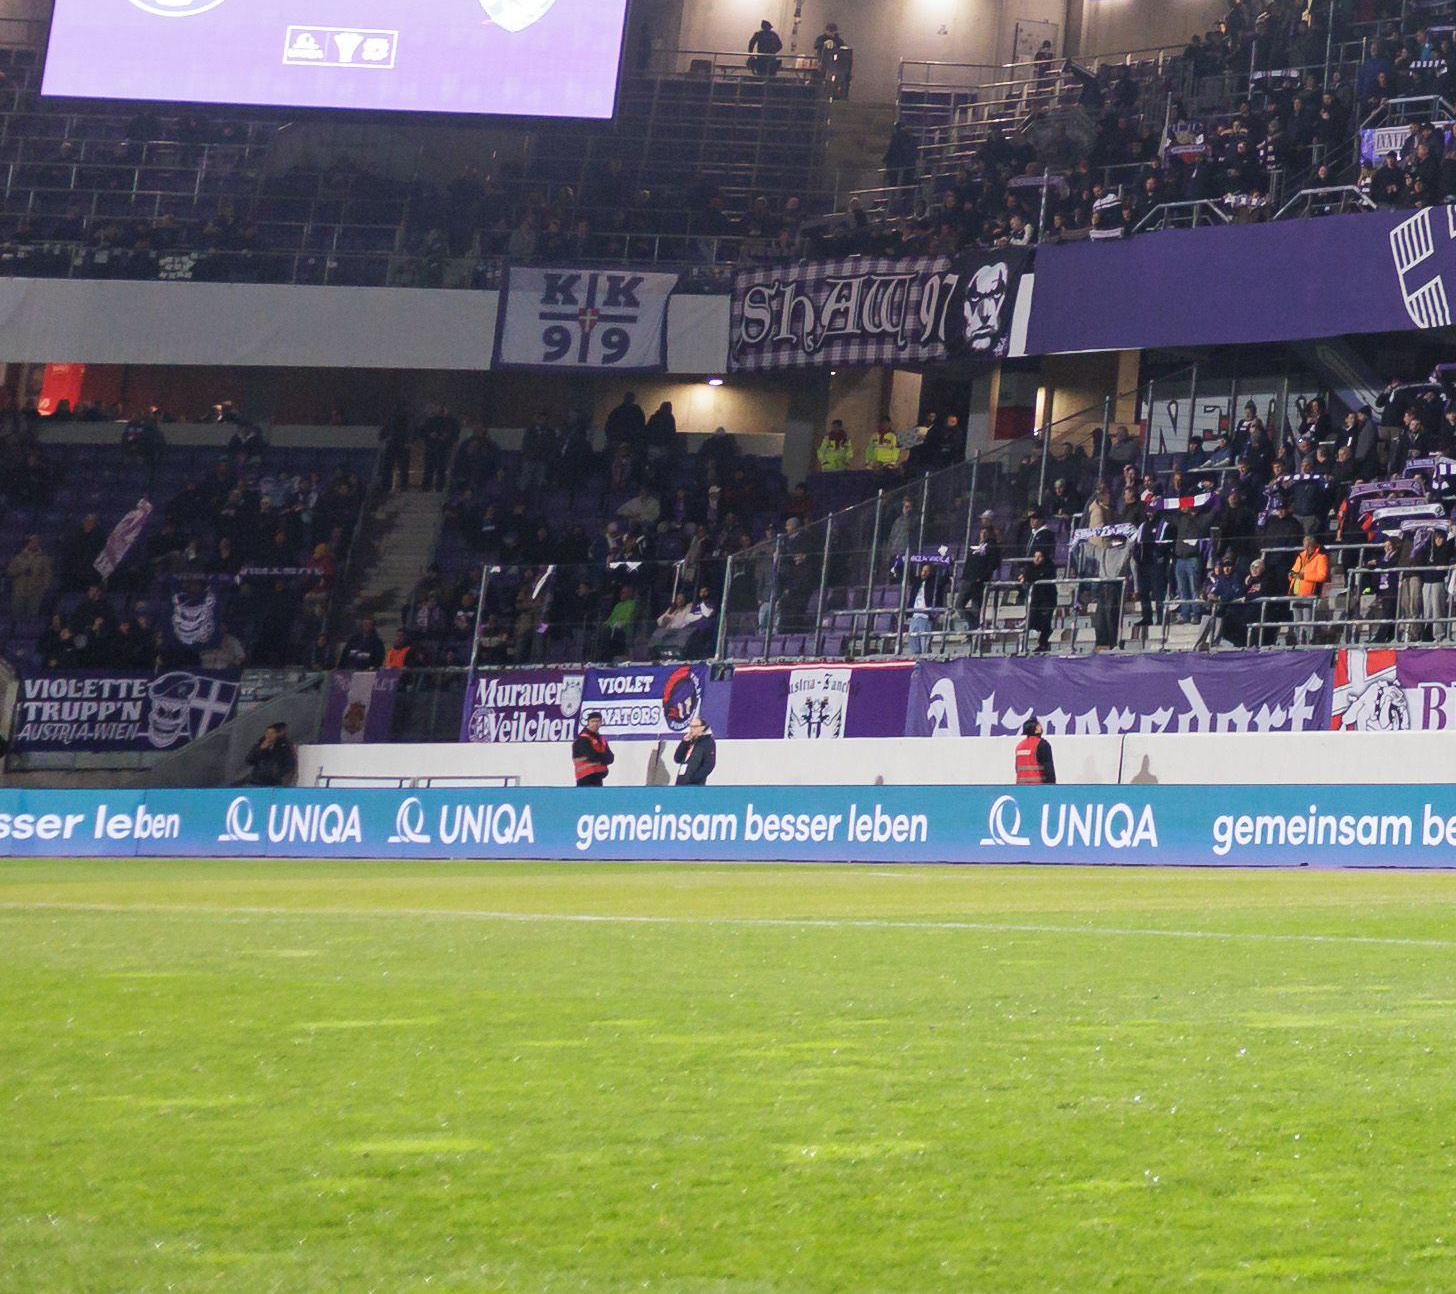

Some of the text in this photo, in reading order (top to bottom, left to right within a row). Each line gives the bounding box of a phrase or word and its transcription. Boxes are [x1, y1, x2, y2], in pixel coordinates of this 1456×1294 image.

[23, 677, 148, 700] VIOLETTE
[475, 678, 563, 709] Murauer
[598, 675, 655, 695] VIOLET
[23, 700, 144, 721] TRUPP'N
[581, 706, 662, 729] SNATORS
[487, 710, 576, 743] Veilchen
[93, 802, 181, 840] leben
[268, 804, 363, 843] UNIQA
[440, 804, 536, 843] UNIQA
[576, 804, 739, 851] gemeinsam
[745, 802, 841, 844] besser
[848, 802, 929, 843] leben
[1040, 803, 1158, 849] UNIQA
[1212, 803, 1413, 856] gemeinsam
